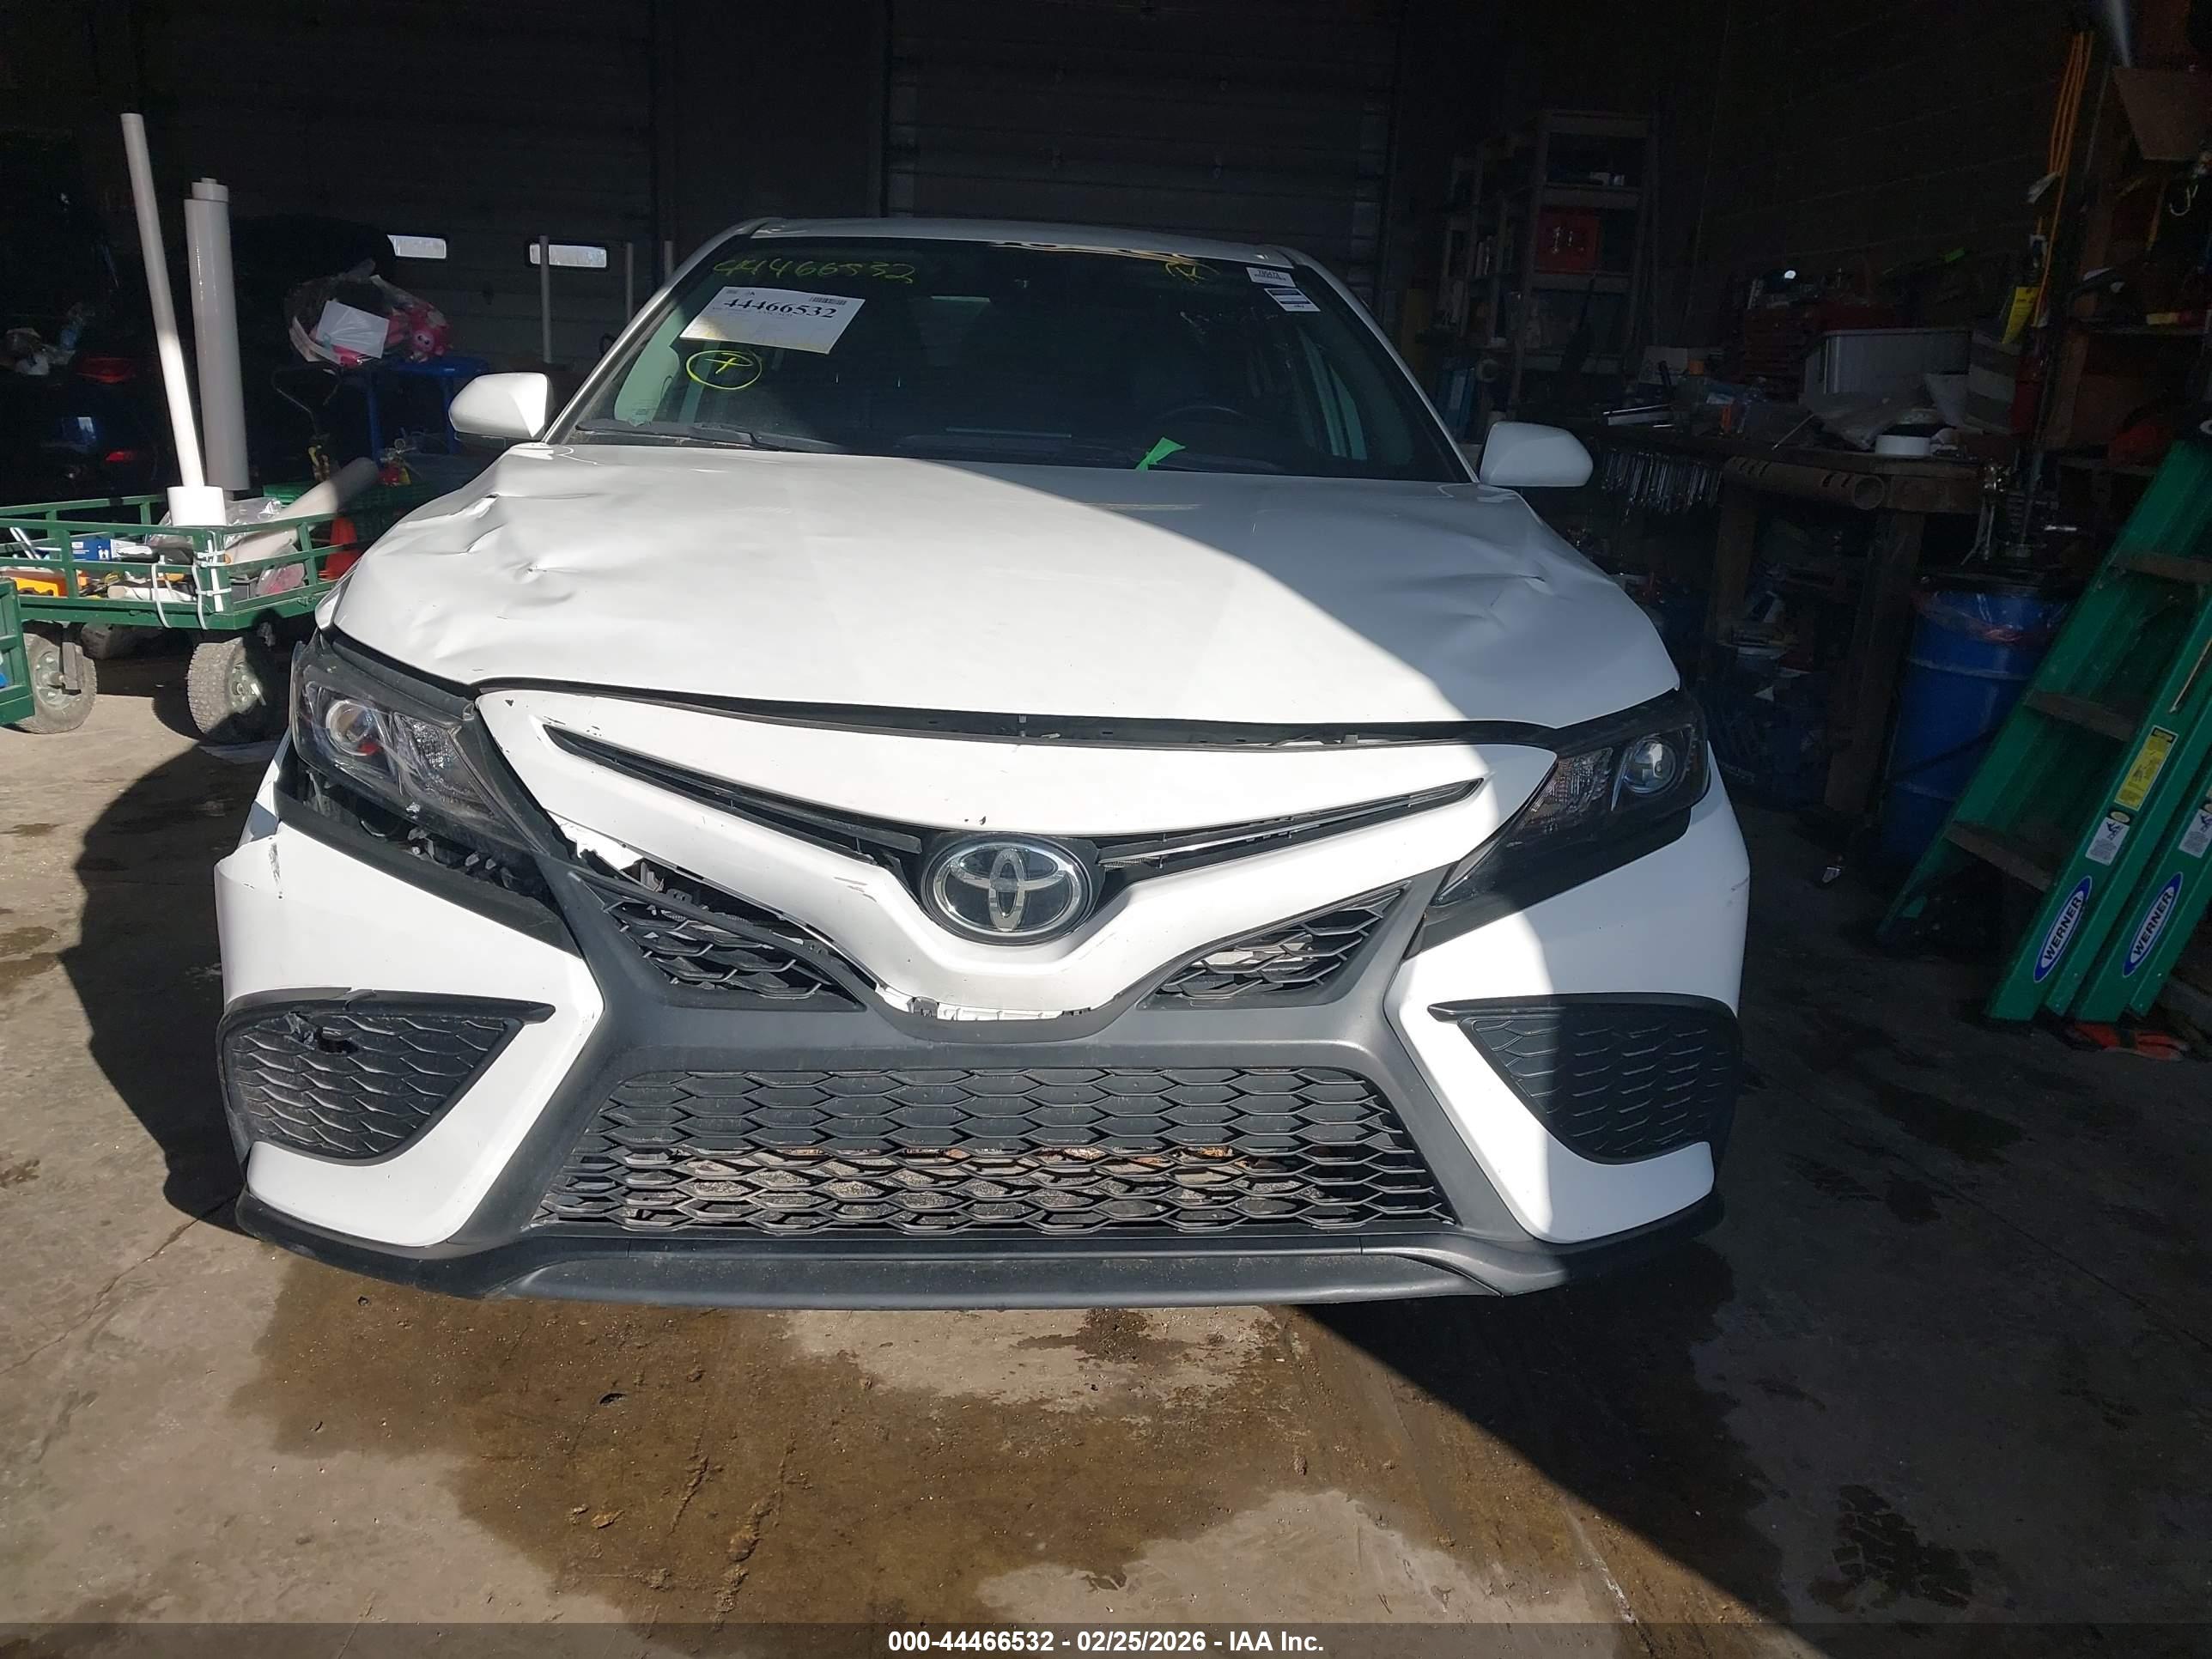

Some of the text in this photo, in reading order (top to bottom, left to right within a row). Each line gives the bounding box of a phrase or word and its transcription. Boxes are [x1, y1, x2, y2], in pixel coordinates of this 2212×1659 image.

[725, 298, 837, 319] 44466532
[2043, 896, 2083, 961] WERNER
[2134, 893, 2173, 956] WERNER
